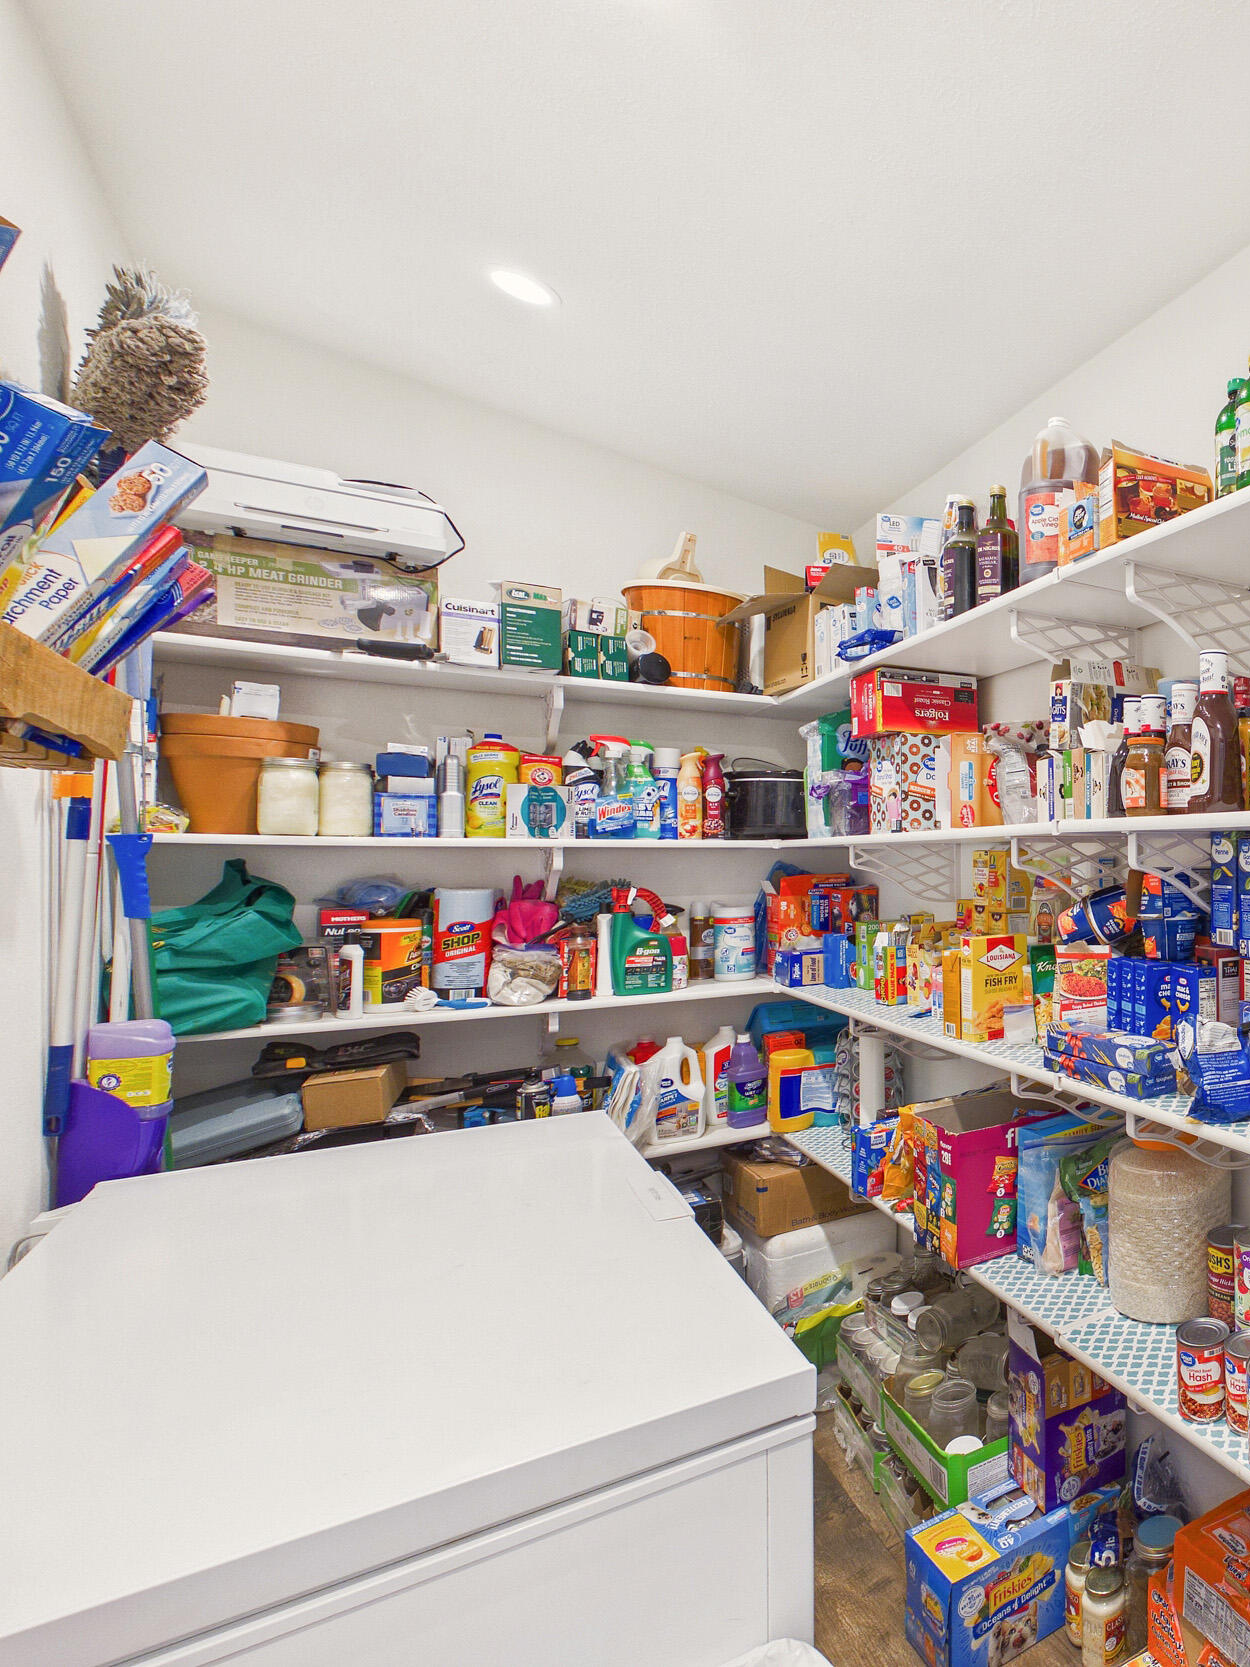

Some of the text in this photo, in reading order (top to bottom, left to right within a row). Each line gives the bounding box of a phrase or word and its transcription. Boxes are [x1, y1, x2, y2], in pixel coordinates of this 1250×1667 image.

[142, 463, 173, 485] 50
[1032, 517, 1047, 526] Apple
[227, 566, 245, 576] HP
[249, 569, 284, 582] MEAT
[288, 573, 343, 589] GRINDER
[39, 577, 80, 612] Paper
[445, 602, 495, 616] Cuisinart
[915, 709, 950, 721] Folgers
[471, 777, 501, 799] Lysol
[598, 803, 632, 822] Windex
[452, 923, 471, 932] Scott
[442, 932, 481, 951] SHOP
[445, 946, 476, 958] ORIGINAL
[986, 952, 1016, 962] LOUISIANA
[985, 975, 1018, 987] FISH FRY
[791, 1215, 809, 1227] Bath
[1188, 1371, 1213, 1382] Hash
[992, 1573, 1032, 1608] Friskies
[981, 1579, 1049, 1632] Oceans Delight
